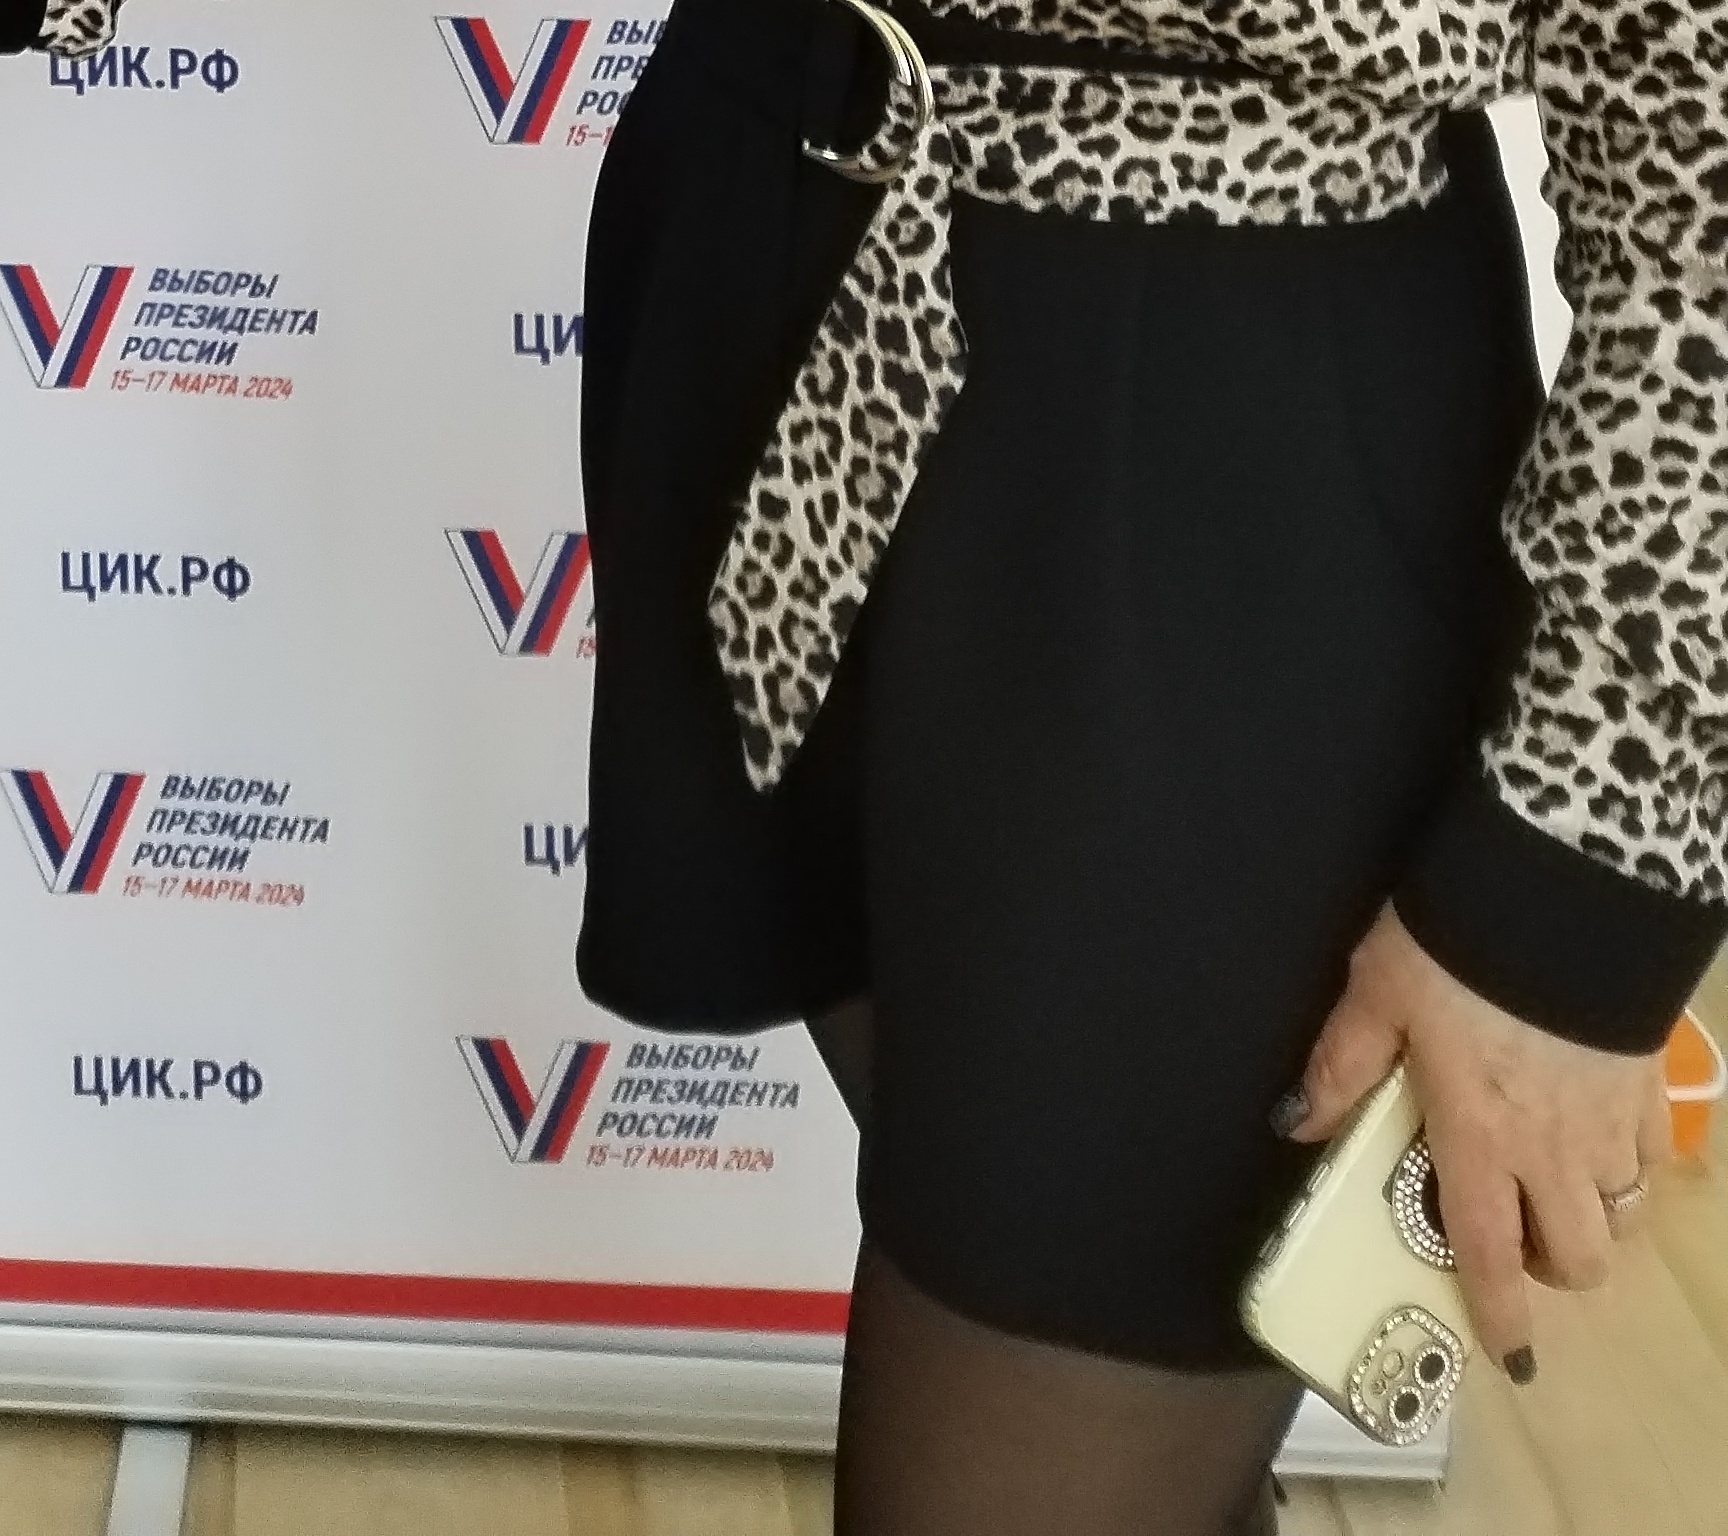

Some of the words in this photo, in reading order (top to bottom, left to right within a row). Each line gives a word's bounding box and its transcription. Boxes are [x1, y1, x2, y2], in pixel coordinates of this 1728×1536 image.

[50, 46, 239, 96] ЦИК.РФ
[147, 266, 279, 299] ВЫБОРЫ
[134, 302, 318, 336] ПРЕЗИДЕНТА
[120, 336, 239, 367] РОССИИ
[169, 371, 239, 397] МАРТА
[243, 375, 293, 400] 2024
[61, 550, 251, 603] ЦИК.РФ
[160, 774, 291, 807] ВЫБОРЫ
[146, 807, 331, 844] ПРЕЗИДЕНТА
[131, 841, 251, 874] РОССИИ
[182, 877, 251, 902] МАРТА
[254, 882, 305, 906] 2024
[625, 1041, 760, 1072] ВЫБОРЫ
[73, 1054, 263, 1106] ЦИК.РФ
[610, 1076, 800, 1110] ПРЕЗИДЕНТА
[596, 1110, 719, 1140] РОССИИ
[647, 1145, 718, 1170] МАРТА
[723, 1146, 774, 1172] 2024
